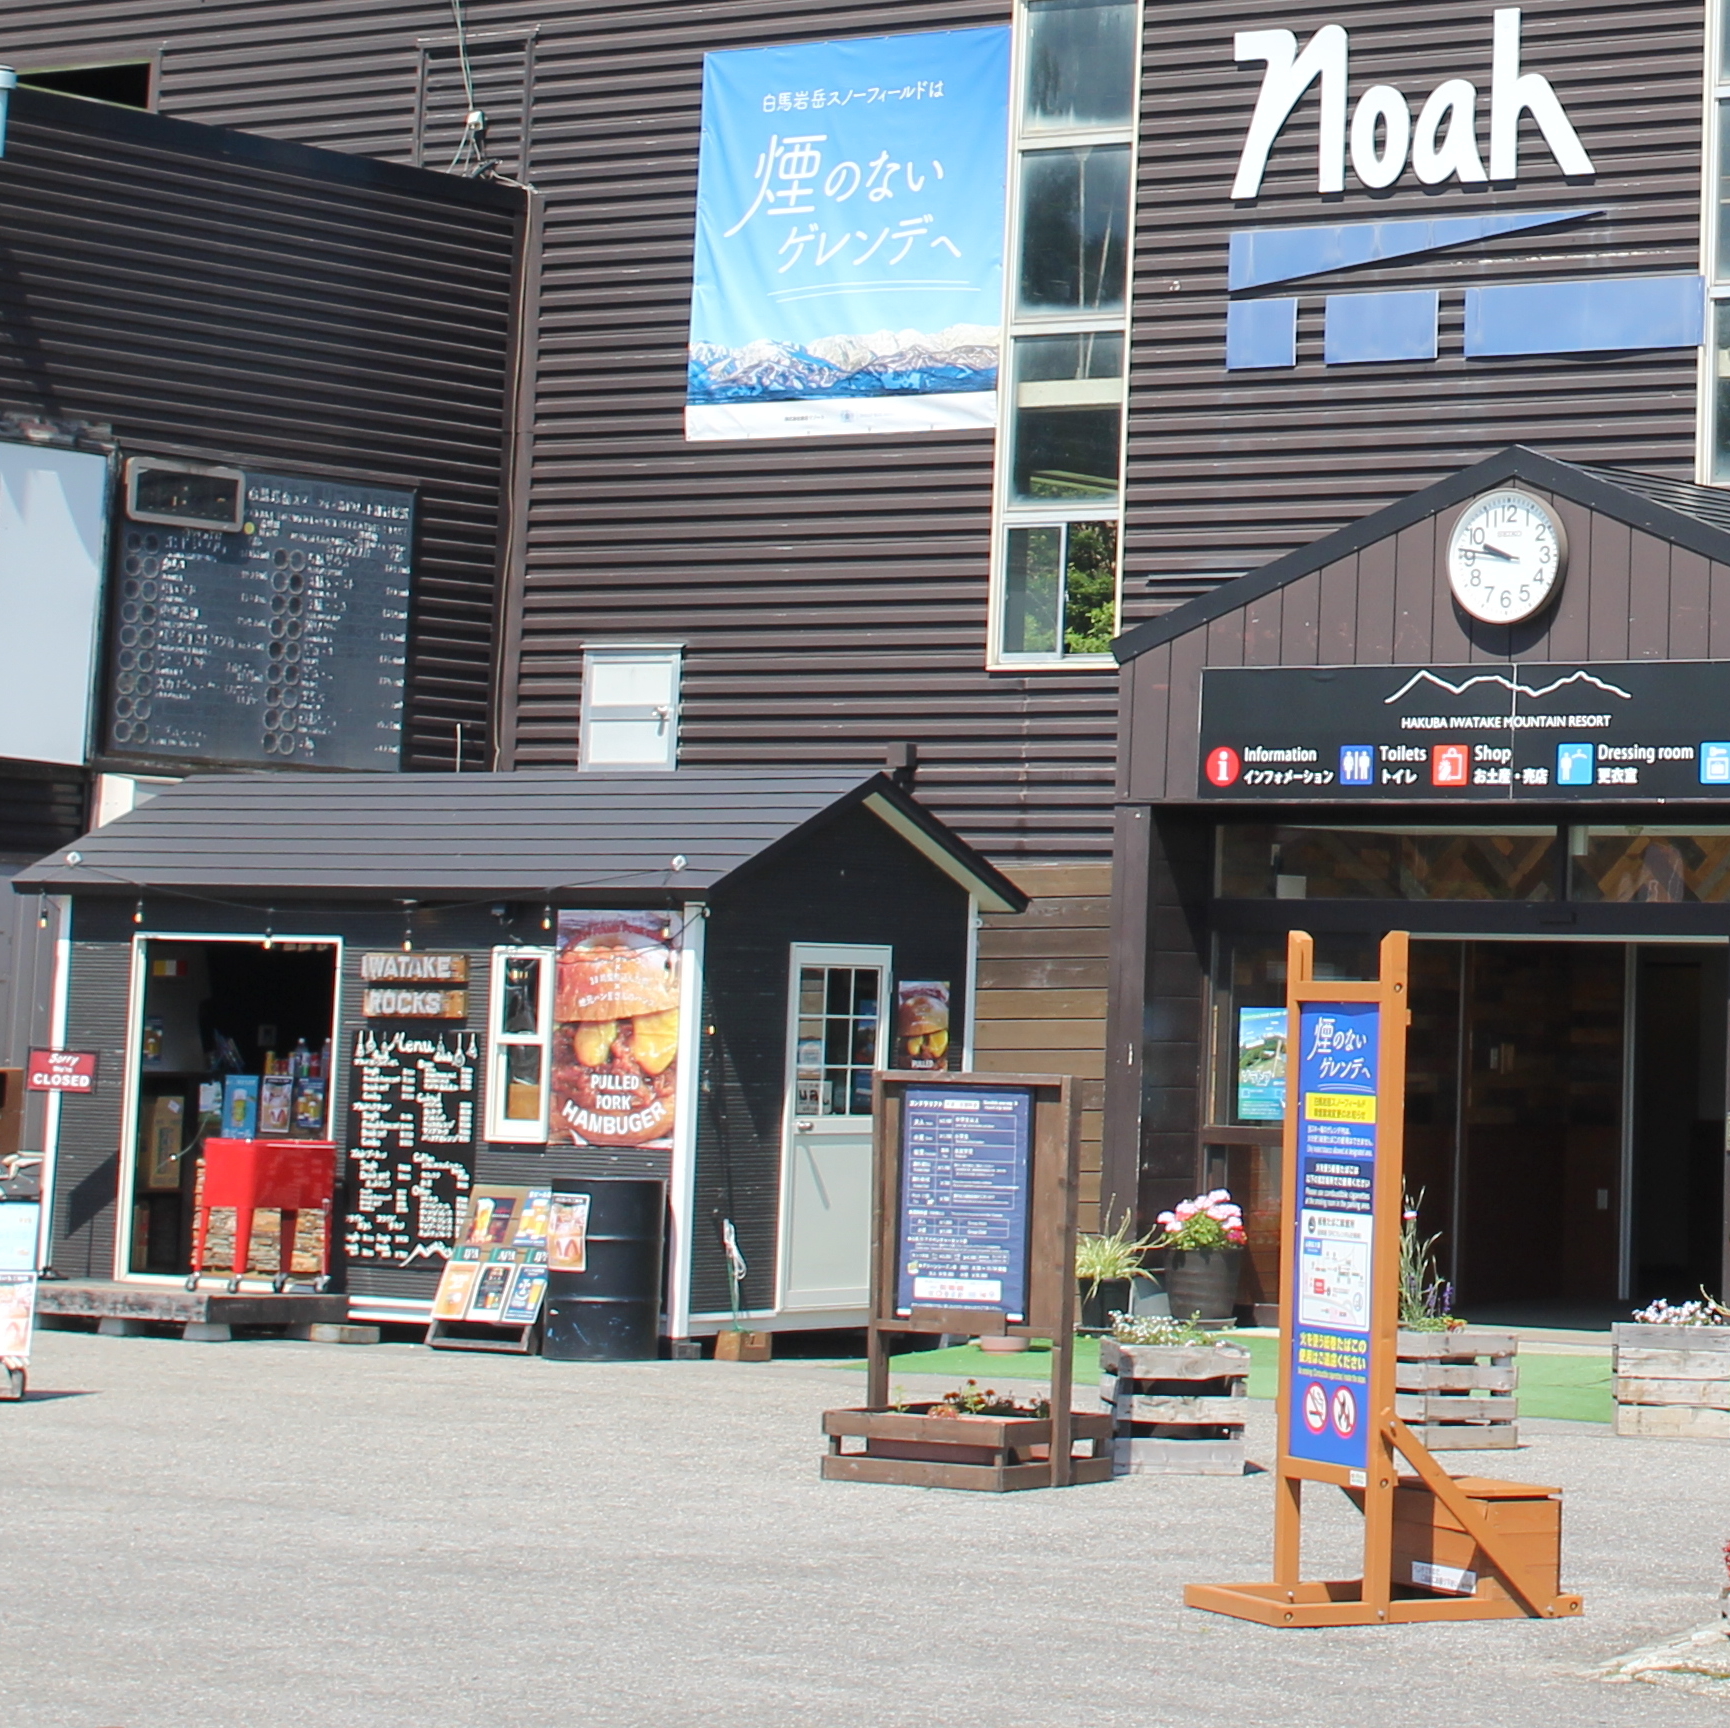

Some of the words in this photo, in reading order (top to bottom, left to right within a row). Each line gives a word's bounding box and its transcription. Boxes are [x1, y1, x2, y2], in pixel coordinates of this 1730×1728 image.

[763, 80, 944, 112] 白馬岩岳スノーフィールドは
[724, 134, 944, 238] 煙のない
[778, 214, 962, 273] ゲレンデへ
[1486, 510, 1497, 528] 11
[1502, 505, 1517, 523] 12
[1469, 527, 1485, 545] 10
[1535, 523, 1546, 541] 2
[1540, 546, 1550, 564] 3
[1470, 569, 1481, 587] 8
[1533, 568, 1544, 584] 4
[1485, 586, 1495, 603] 7
[1500, 590, 1512, 608] 6
[1519, 584, 1530, 602] 5
[1402, 717, 1448, 729] HAKUBA
[1450, 716, 1501, 729] IWATAKE
[1503, 715, 1566, 728] MOUNTAIN
[1568, 714, 1612, 727] RESORT
[1244, 746, 1317, 762] Information
[1380, 746, 1427, 762] Toilets
[1474, 746, 1512, 765] Shop
[1597, 744, 1656, 763] Dressing
[1658, 747, 1694, 760] room
[1244, 769, 1335, 785] インフォメーション
[1381, 770, 1418, 785] トイレ
[1474, 768, 1549, 785] お土産・売店
[1597, 767, 1638, 784] 更衣室
[361, 955, 452, 979] IWATAKE
[370, 991, 443, 1014] ROCKS
[388, 1032, 436, 1054] Menu
[1307, 1017, 1367, 1060] 煙のない
[1319, 1056, 1371, 1079] ゲレンデへ
[33, 1073, 90, 1087] CLOSED
[590, 1074, 640, 1090] PULLED
[596, 1095, 632, 1110] PORK
